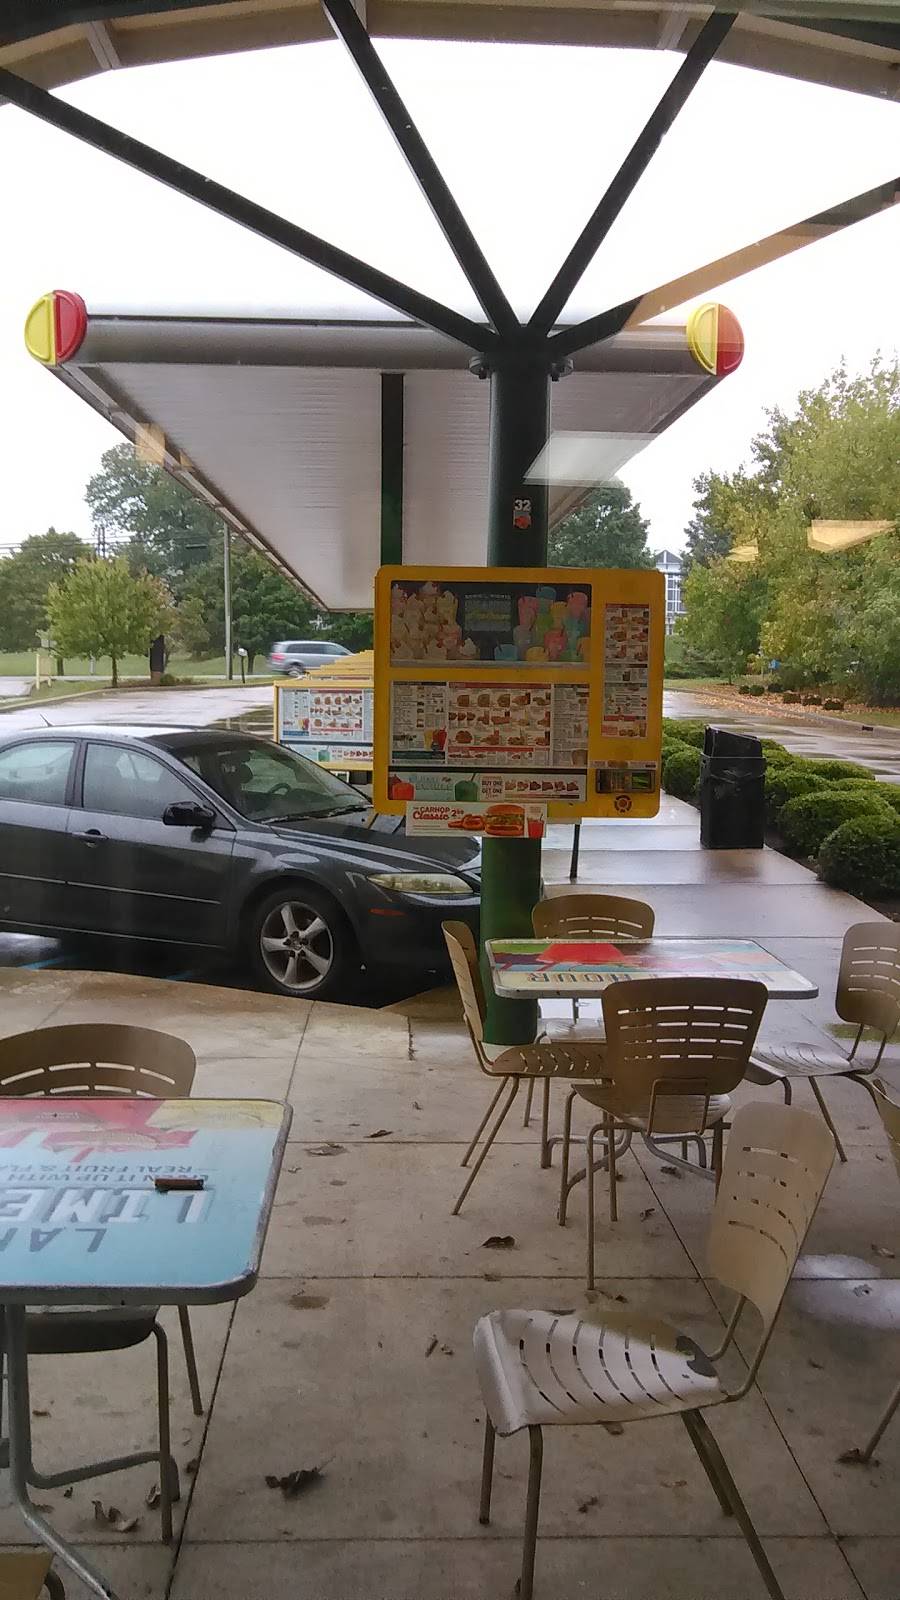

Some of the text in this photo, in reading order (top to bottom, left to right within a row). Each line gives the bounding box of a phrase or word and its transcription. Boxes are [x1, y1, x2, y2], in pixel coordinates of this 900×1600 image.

[514, 499, 531, 512] 32
[412, 810, 450, 820] Classic
[527, 972, 633, 983] HOUR
[39, 1164, 56, 1172] &
[64, 1164, 129, 1173] FRUIT
[137, 1165, 193, 1173] REAL
[7, 1174, 70, 1182] WITH
[78, 1174, 110, 1182] UP
[114, 1174, 136, 1182] IT
[0, 1188, 212, 1224] LIME
